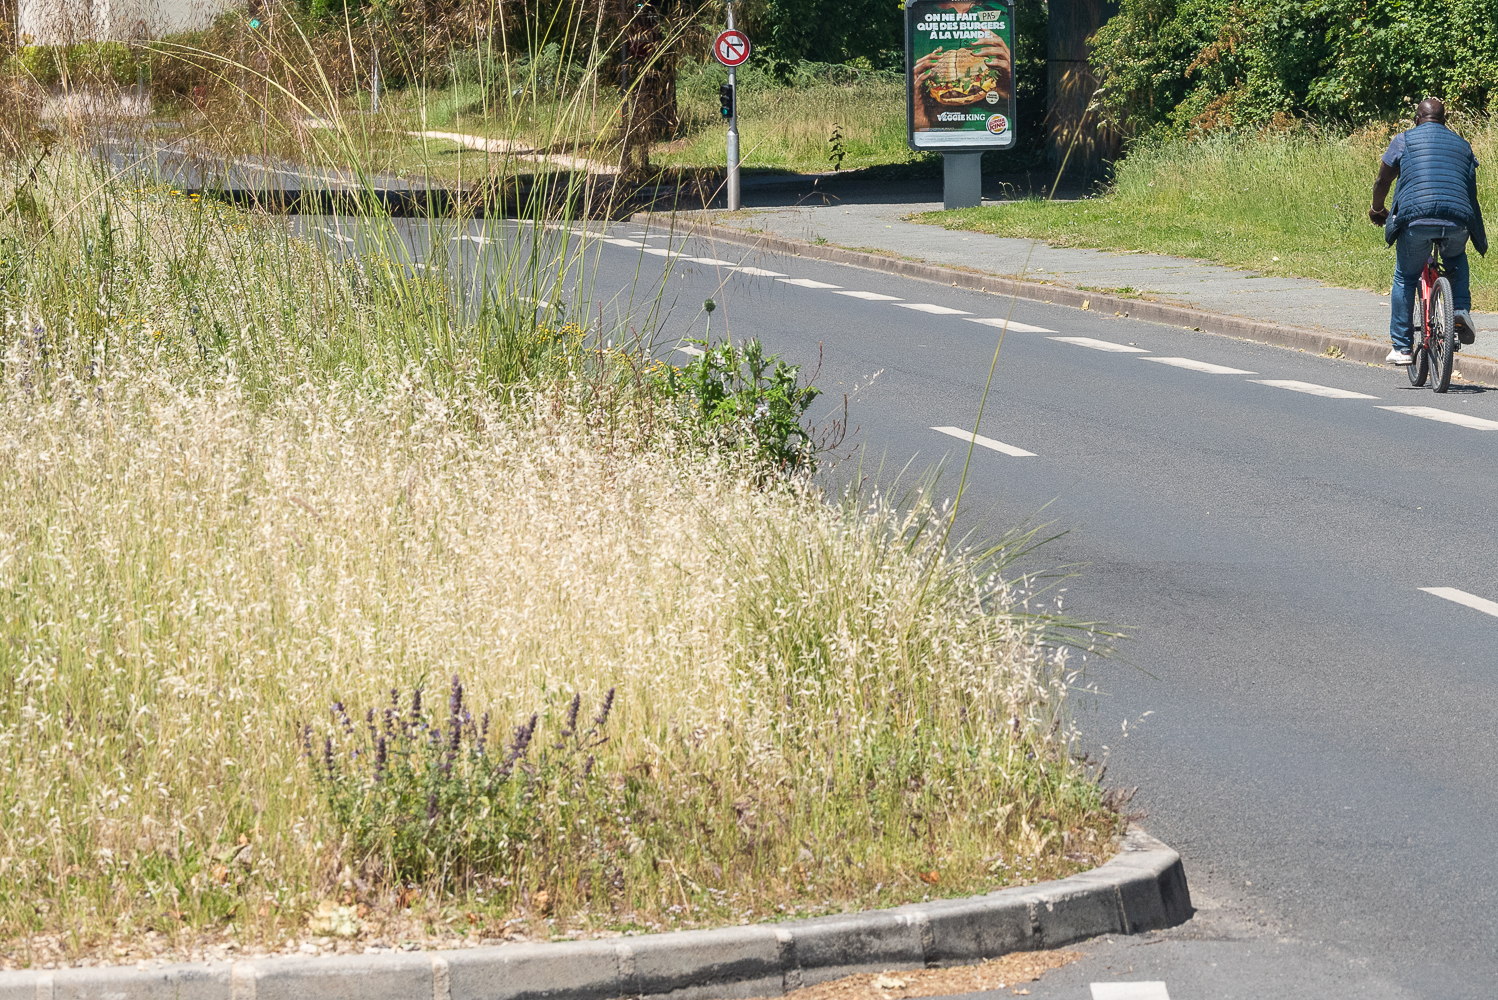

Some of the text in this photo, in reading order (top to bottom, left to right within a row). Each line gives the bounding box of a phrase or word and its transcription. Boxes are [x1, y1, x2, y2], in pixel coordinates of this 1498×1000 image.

[924, 11, 996, 22] ON NE FAIT PAS
[916, 21, 1006, 31] QUE DES BURGERS
[929, 29, 994, 40] À LA VIANDE.
[936, 112, 966, 122] VEGGIE
[966, 113, 986, 121] KING
